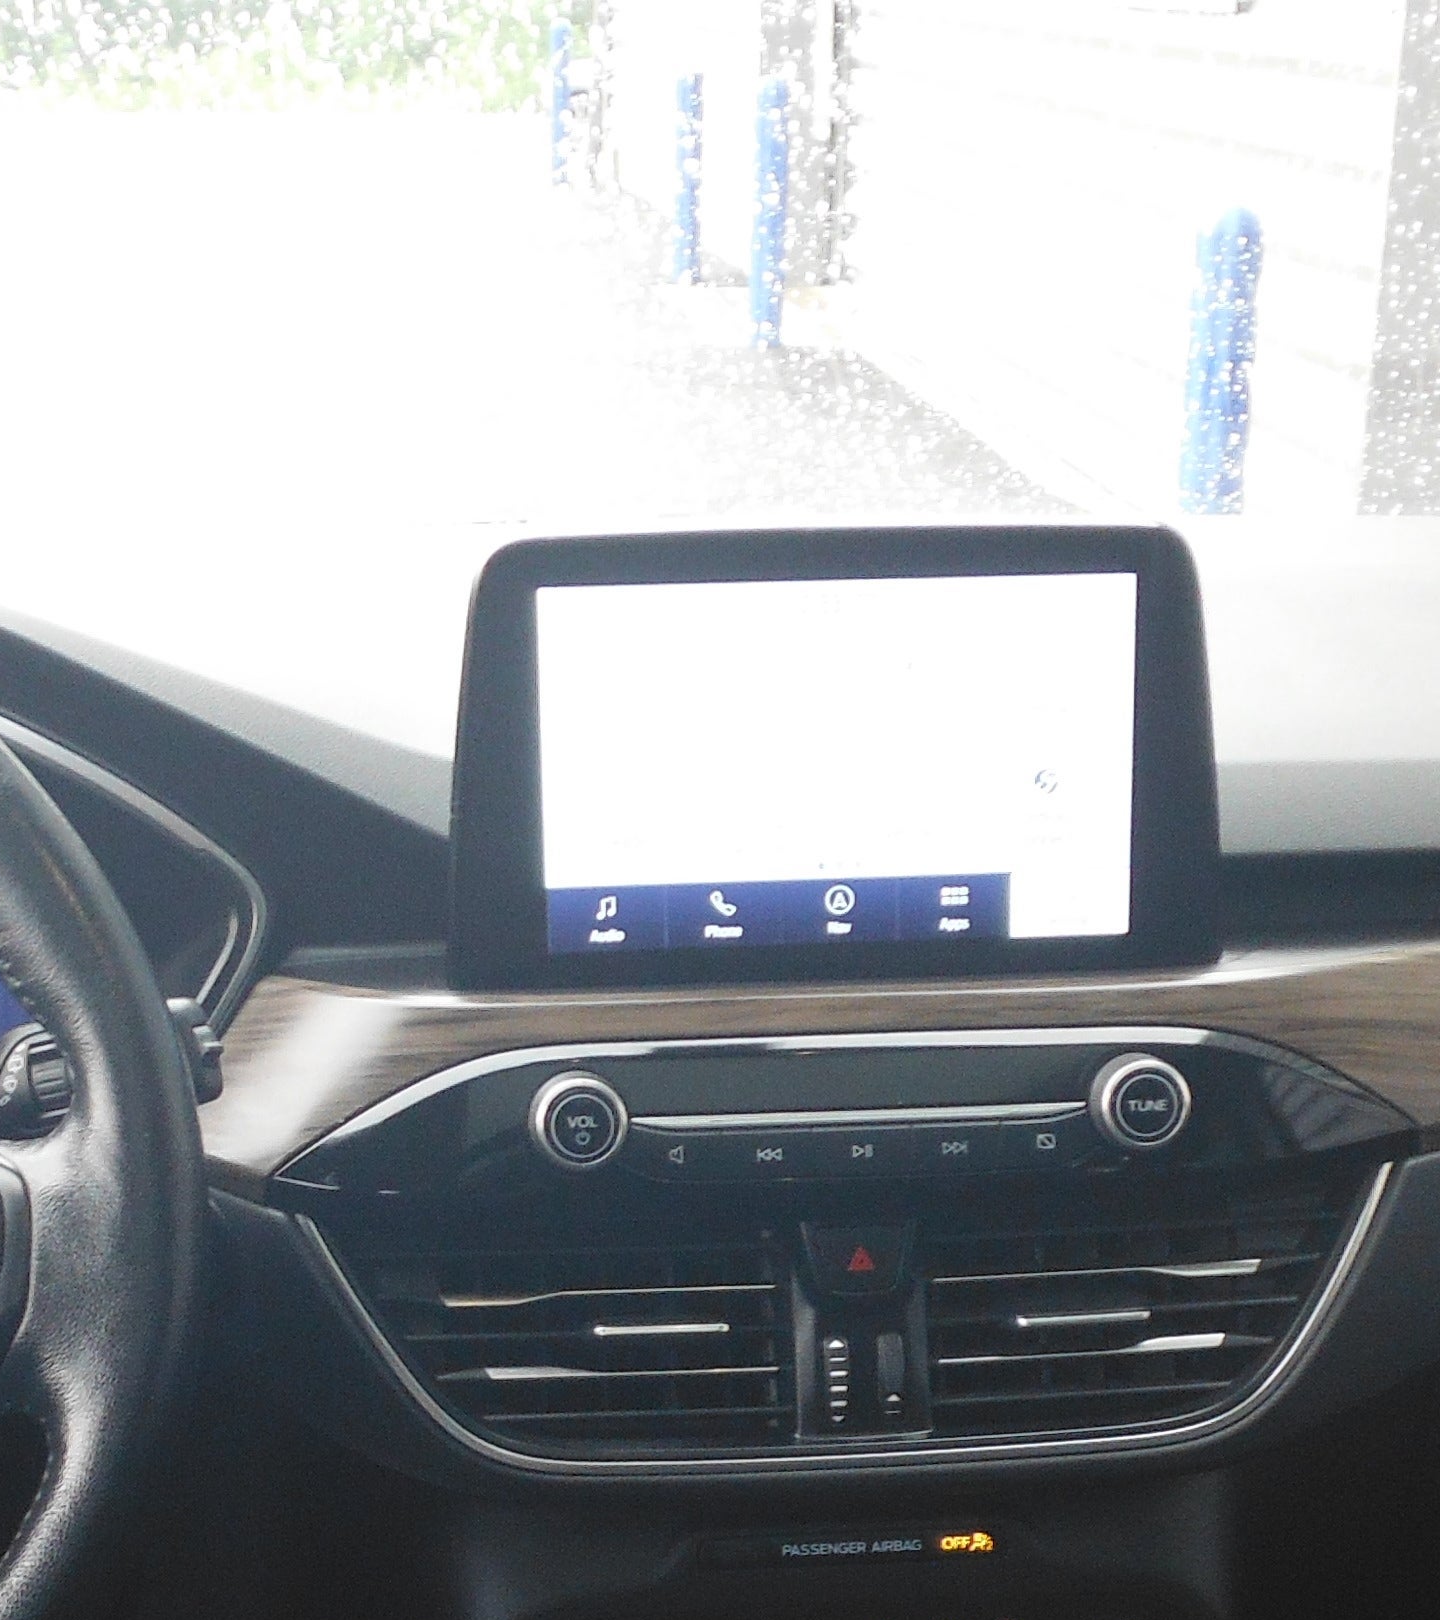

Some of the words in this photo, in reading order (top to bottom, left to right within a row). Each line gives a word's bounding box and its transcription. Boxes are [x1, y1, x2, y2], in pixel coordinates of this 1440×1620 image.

[704, 924, 743, 939] Phone
[938, 917, 970, 933] Apps
[1127, 1098, 1169, 1112] TUNE
[566, 1115, 599, 1129] VOL
[781, 1541, 867, 1557] PASSENGER
[871, 1539, 923, 1553] AIRBAG
[940, 1535, 971, 1551] OFF
